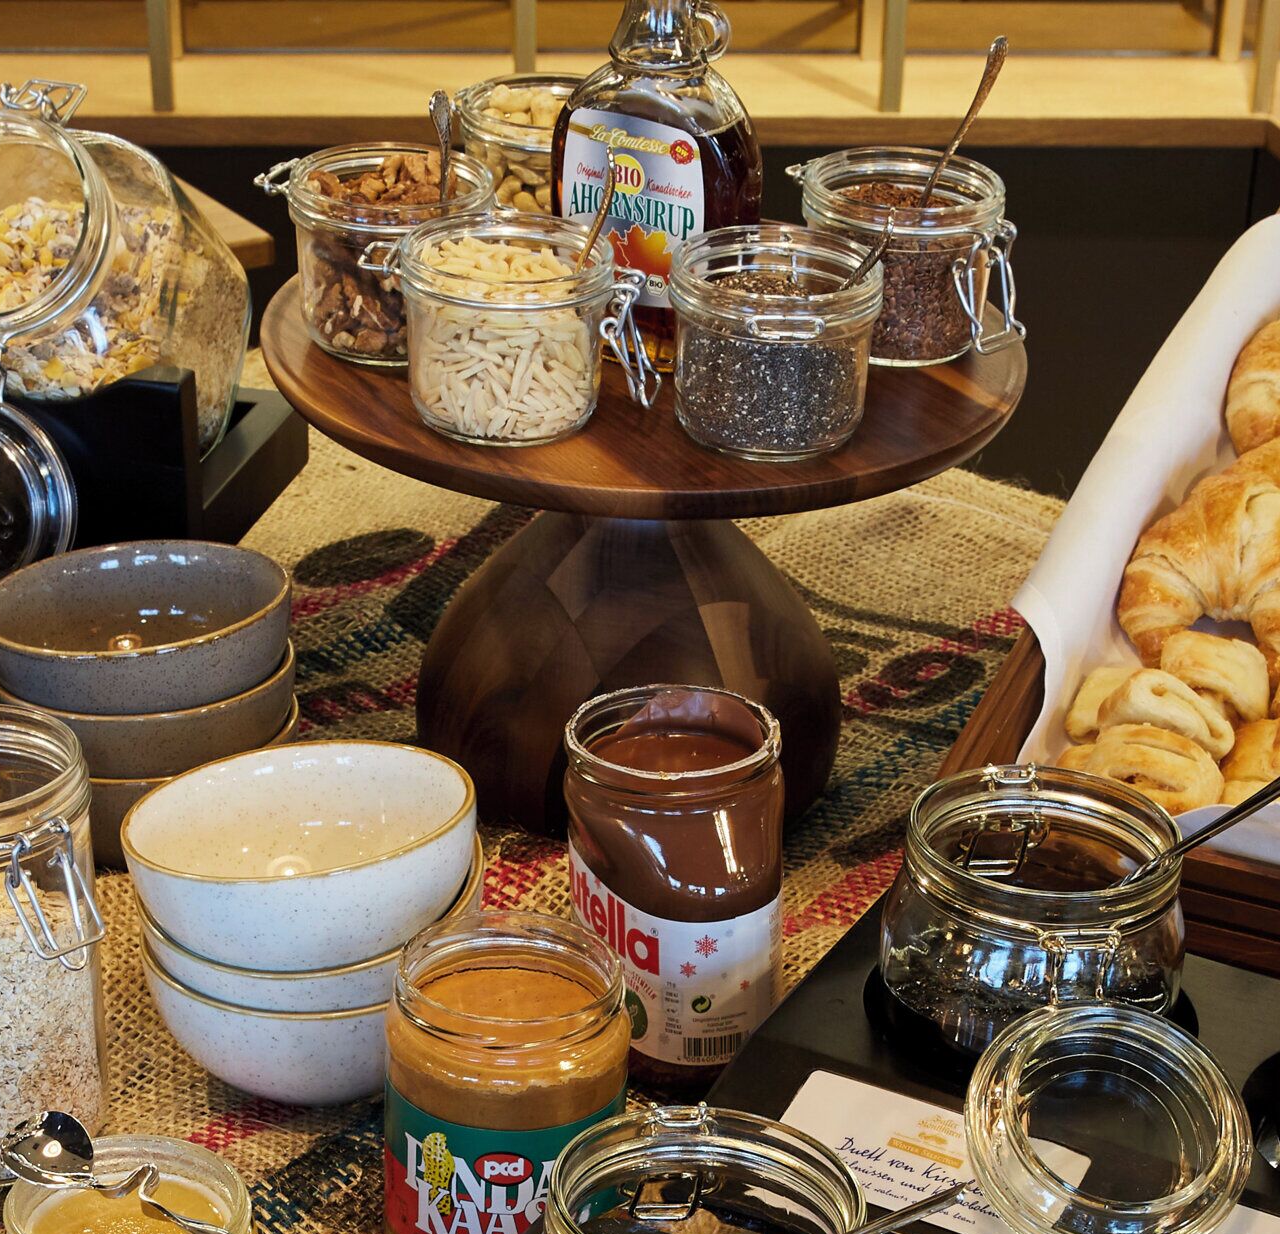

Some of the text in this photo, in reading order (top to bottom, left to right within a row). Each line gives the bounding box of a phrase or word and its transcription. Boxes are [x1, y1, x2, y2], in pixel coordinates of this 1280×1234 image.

[577, 162, 694, 199] Original BIO Kanadischer
[835, 1136, 887, 1162] Duett
[887, 1158, 915, 1173] von
[901, 1180, 926, 1193] und
